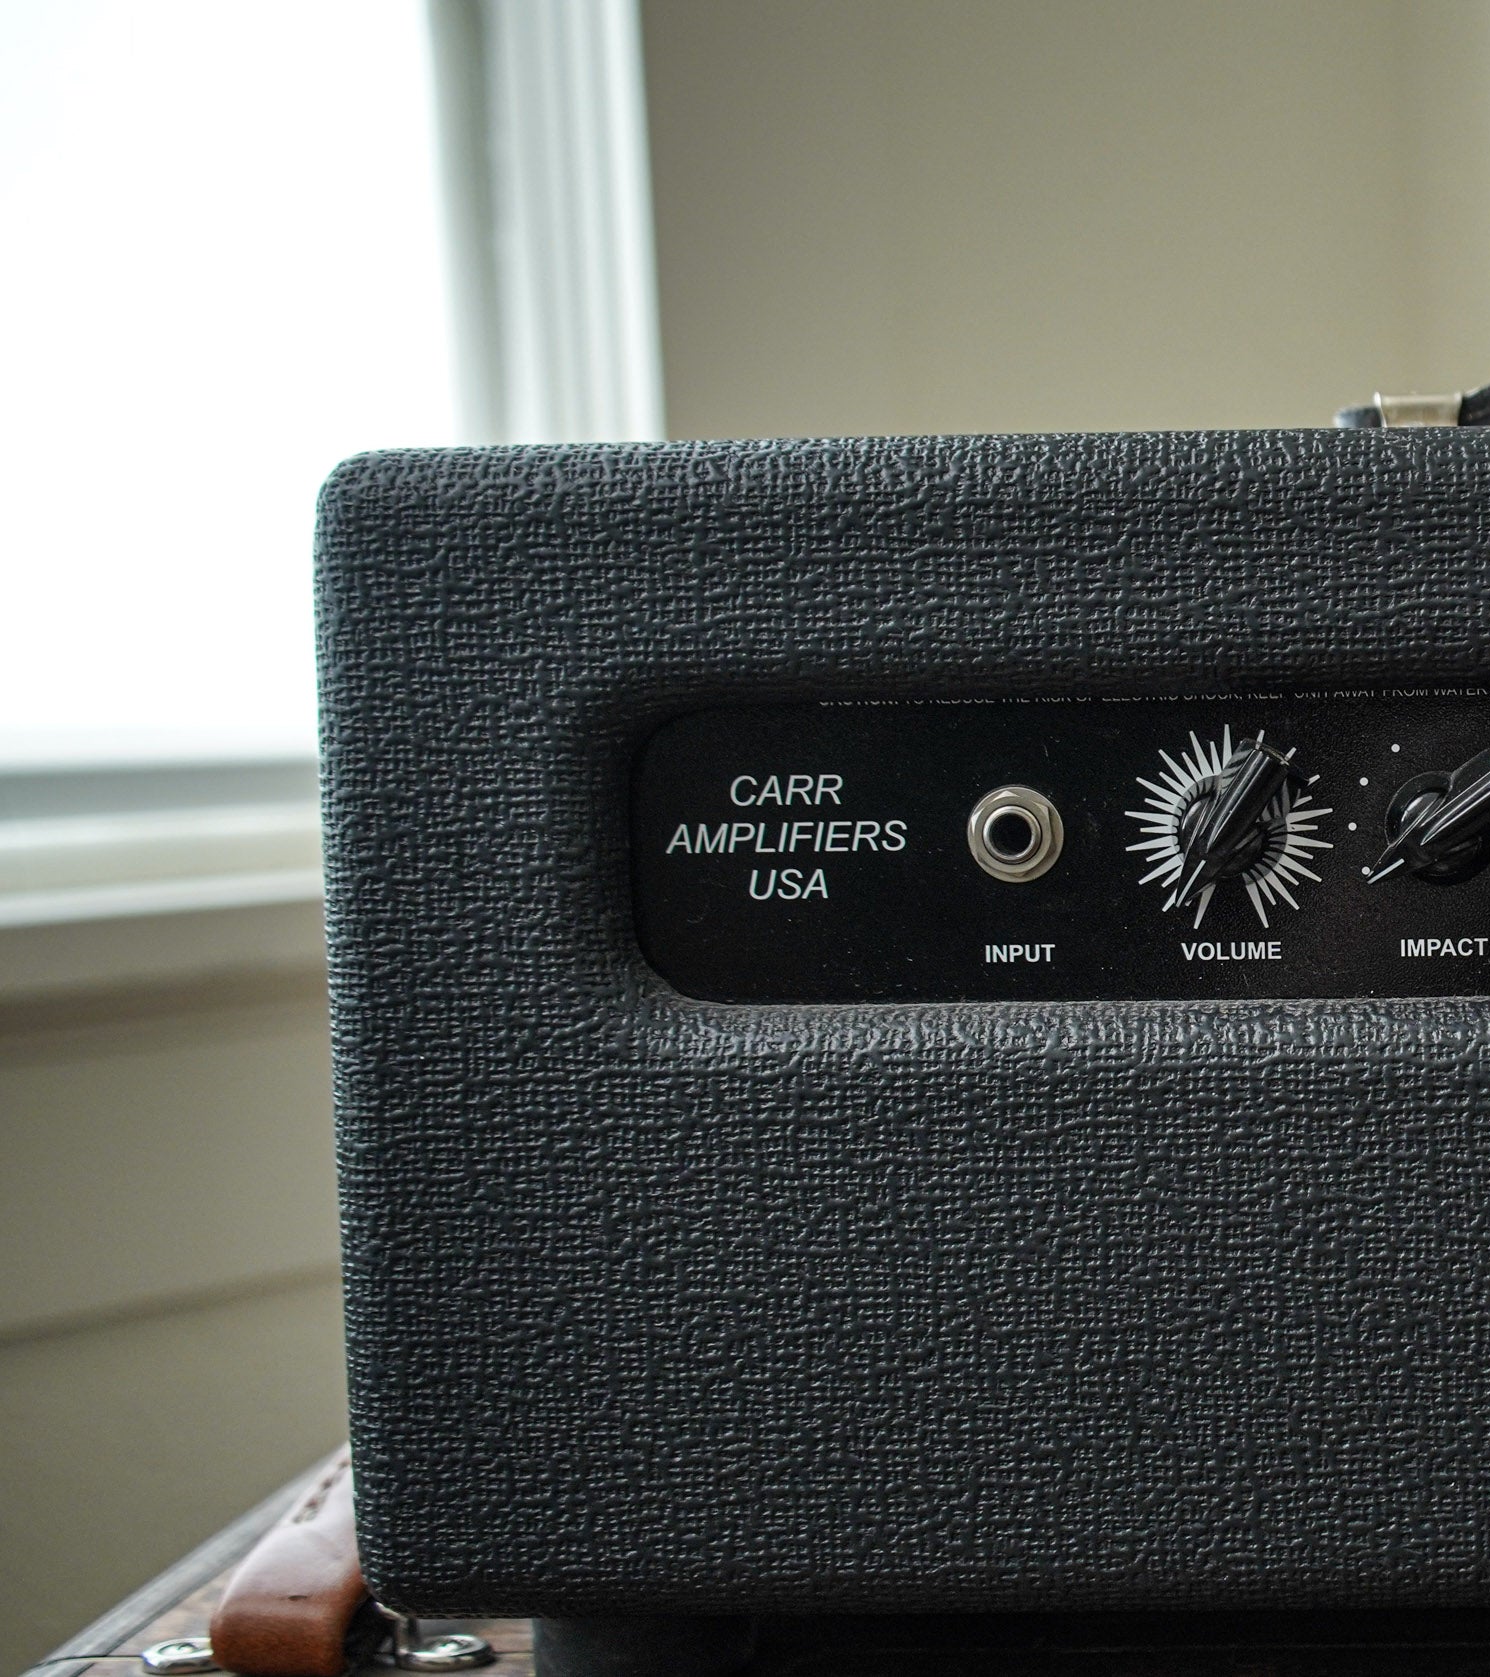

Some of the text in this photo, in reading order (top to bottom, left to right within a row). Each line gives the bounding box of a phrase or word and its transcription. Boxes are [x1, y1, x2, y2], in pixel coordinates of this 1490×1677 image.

[731, 774, 843, 807] CARR
[666, 820, 908, 854] AMPLIFIERS
[749, 868, 829, 900] USA
[985, 944, 1056, 963] INPUT
[1181, 941, 1282, 961] VOLUME
[1400, 937, 1489, 957] IMPACT
